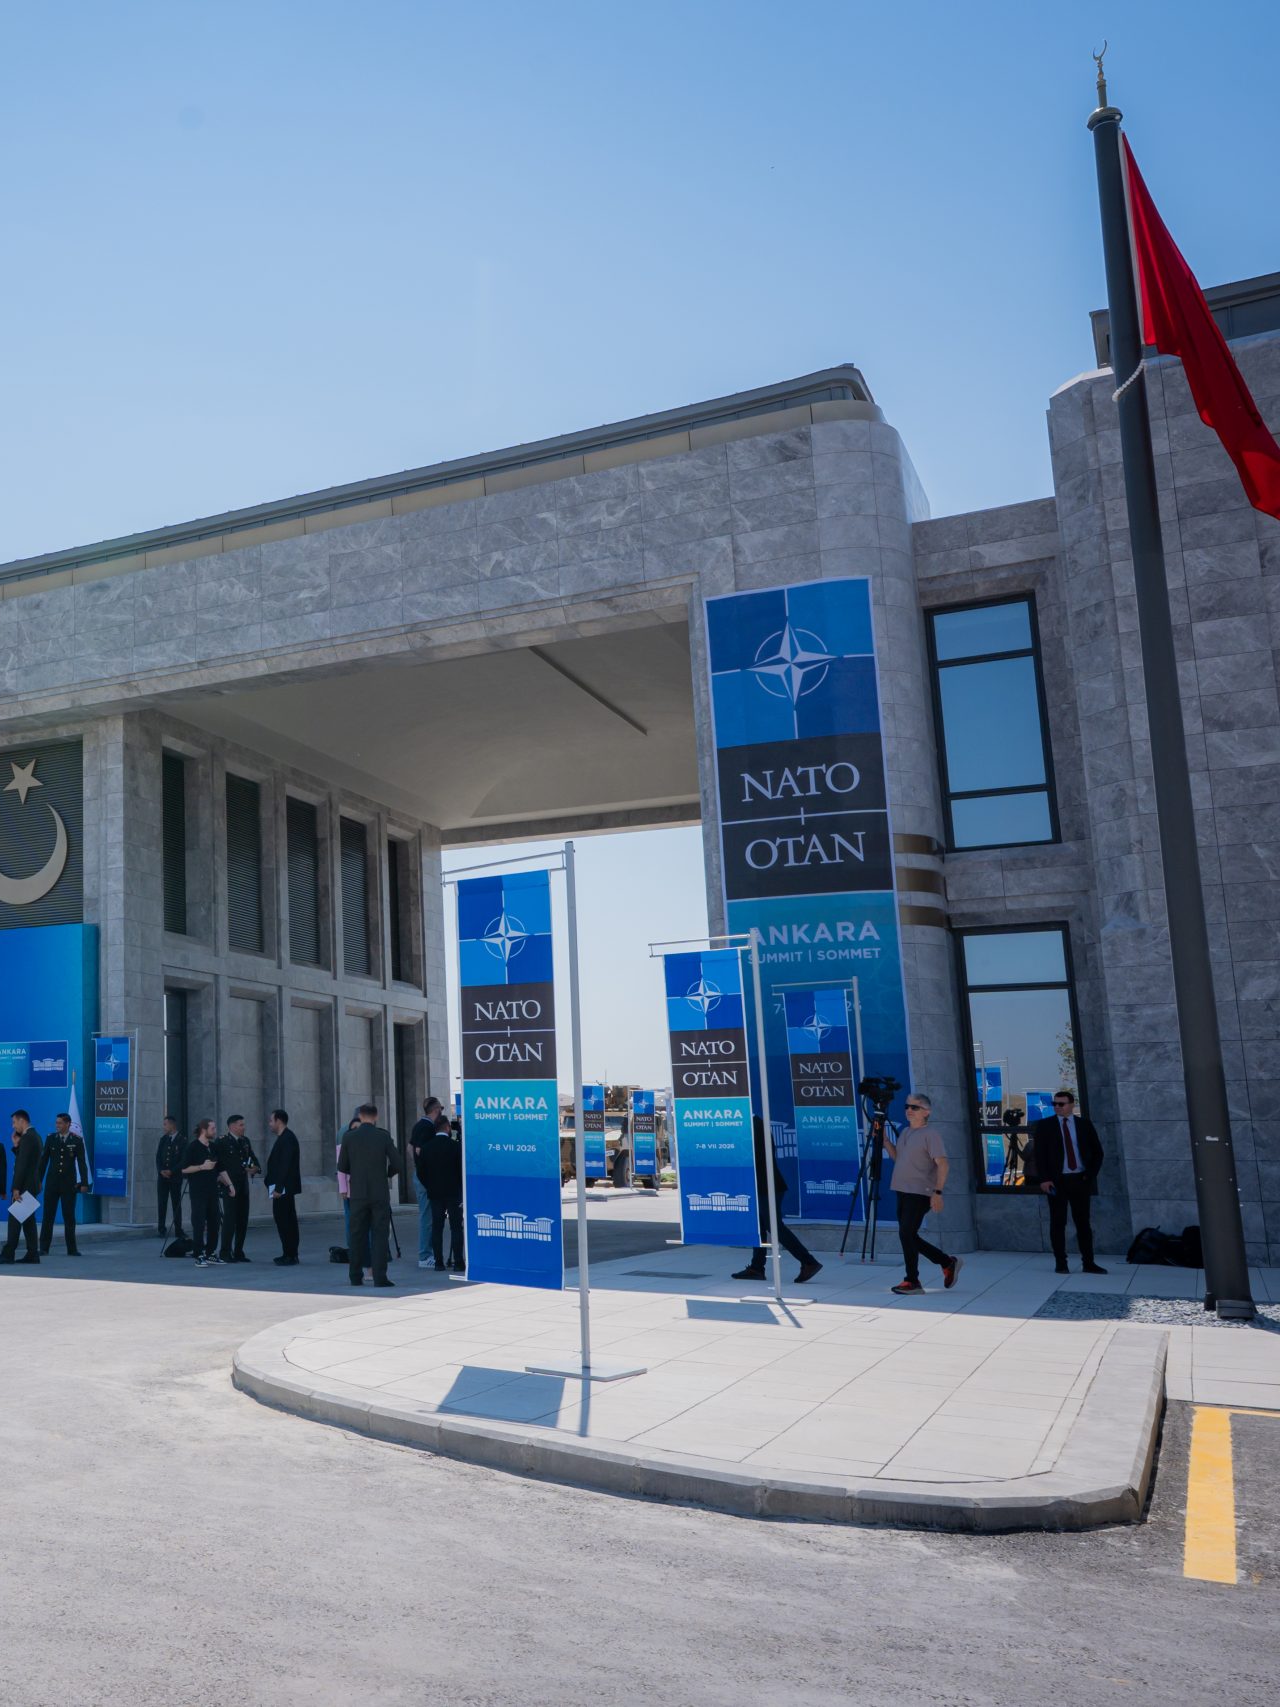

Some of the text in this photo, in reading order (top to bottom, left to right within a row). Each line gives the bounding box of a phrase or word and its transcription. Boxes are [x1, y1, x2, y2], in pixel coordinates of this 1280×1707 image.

[740, 762, 860, 802] NATO
[745, 832, 866, 869] OTAN
[817, 947, 881, 961] SOMMET
[474, 999, 541, 1021] NATO
[475, 1042, 543, 1063] OTAN
[680, 1040, 735, 1056] NATO
[799, 1061, 843, 1074] NATO
[682, 1070, 738, 1086] OTAN
[100, 1086, 124, 1095] NATO
[800, 1085, 845, 1098] OTAN
[99, 1103, 124, 1111] OTAN
[474, 1096, 548, 1109] ANKARA
[513, 1113, 548, 1121] SOMMET
[683, 1109, 743, 1120] ANKARA
[516, 1144, 537, 1152] 2026
